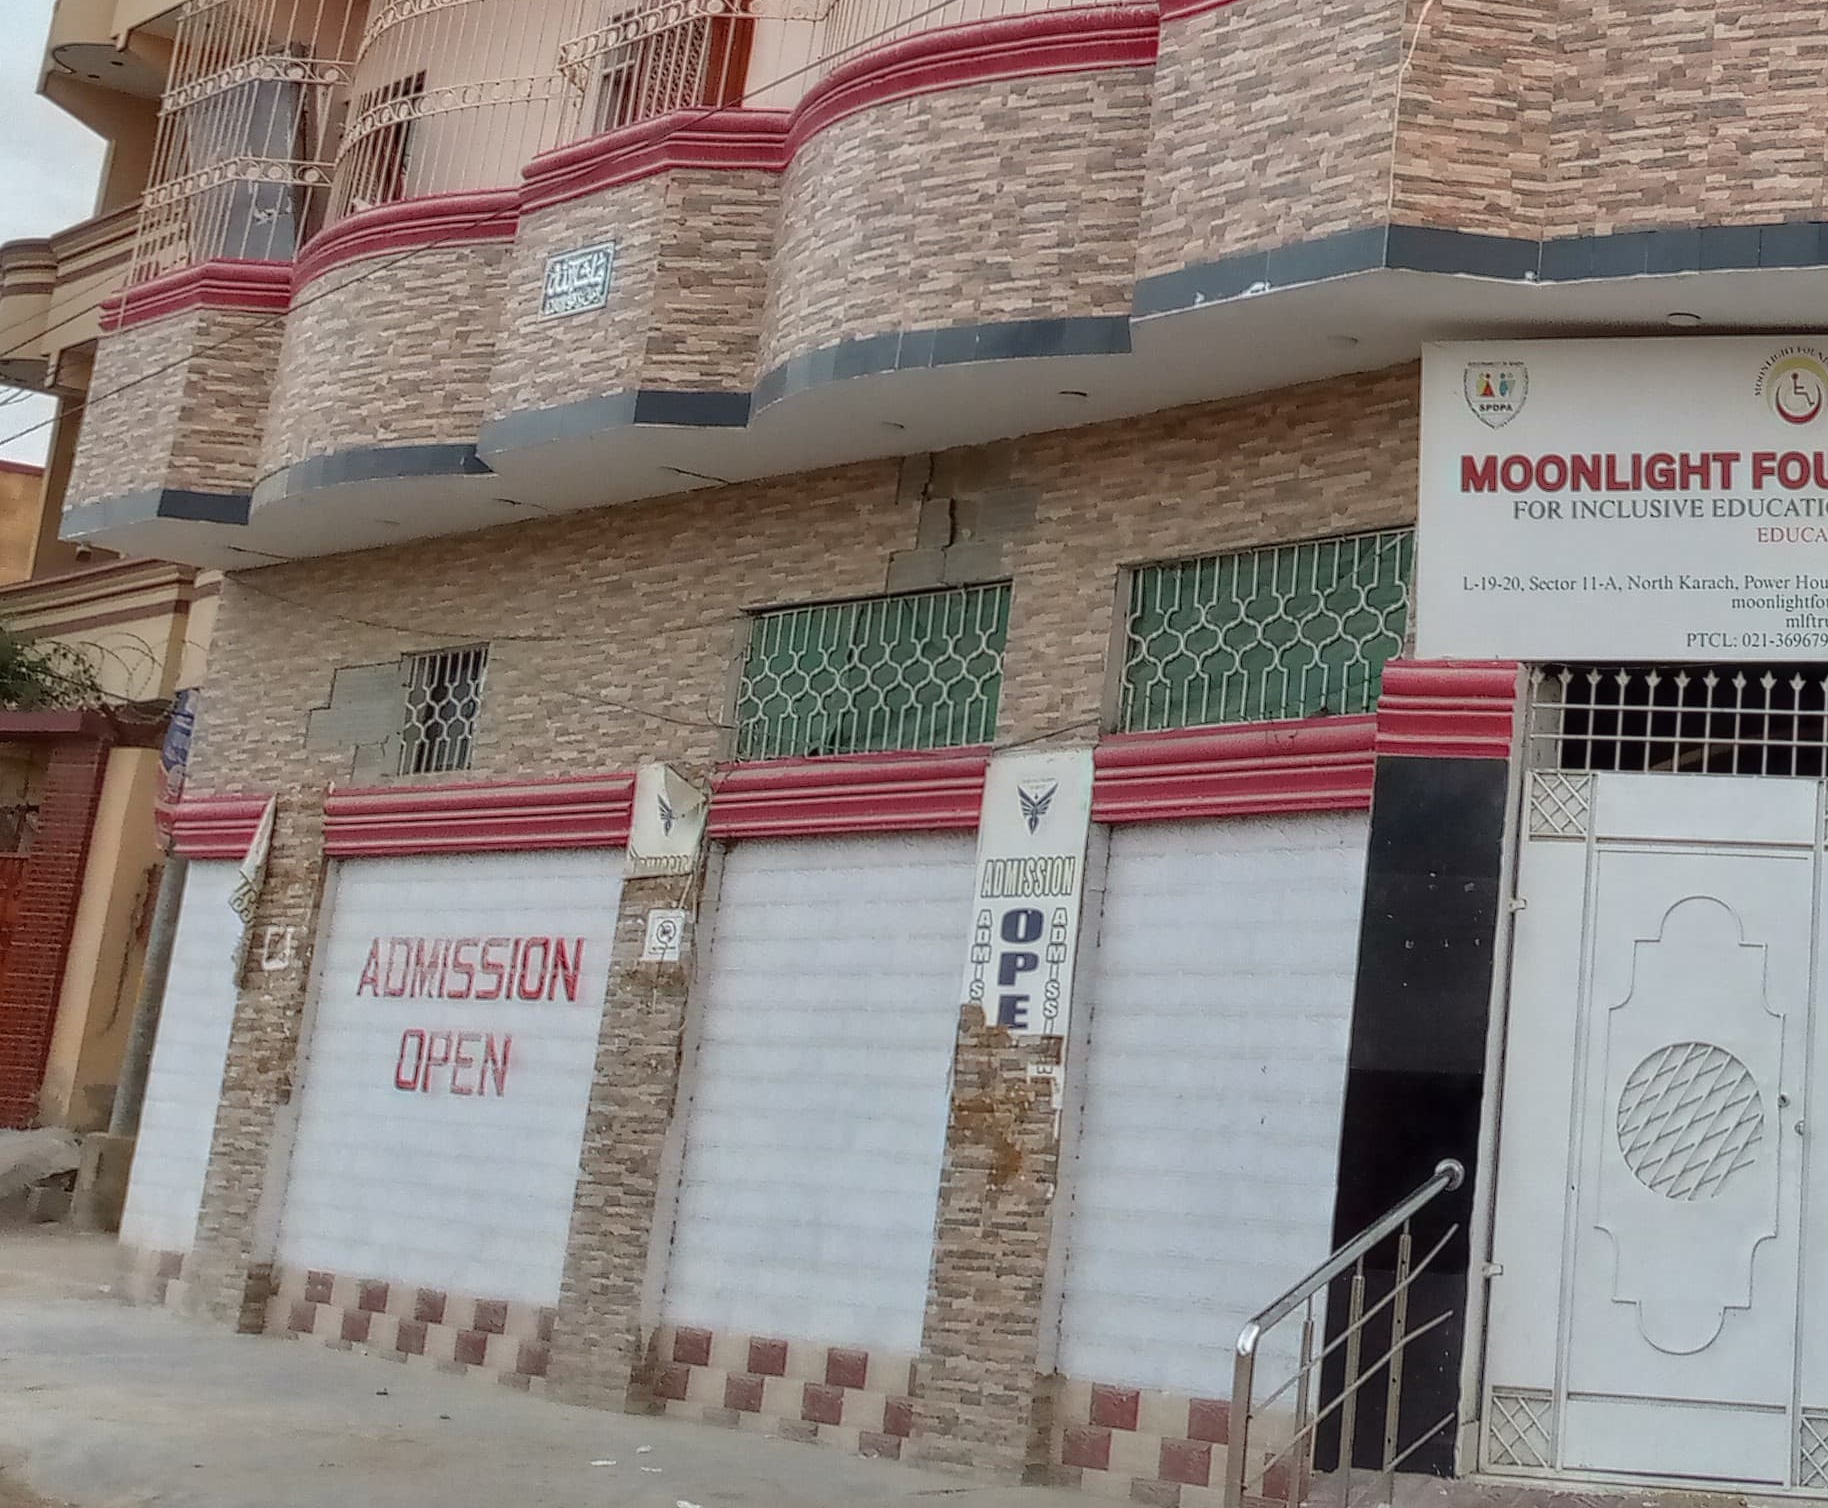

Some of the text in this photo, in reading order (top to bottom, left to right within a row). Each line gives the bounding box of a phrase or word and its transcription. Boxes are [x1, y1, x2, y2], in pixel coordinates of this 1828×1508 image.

[1460, 451, 1740, 492] MOONLIGHT
[1512, 500, 1563, 519] FOR
[1570, 500, 1706, 519] INCLUSIVE
[1529, 576, 1577, 591] Sector
[1627, 575, 1674, 591] North
[1744, 575, 1791, 591] Power
[1686, 632, 1738, 648] PTCL:
[980, 855, 1076, 898] ADMISSION
[356, 936, 585, 1002] ADMISSION
[394, 1028, 512, 1098] OPEN
